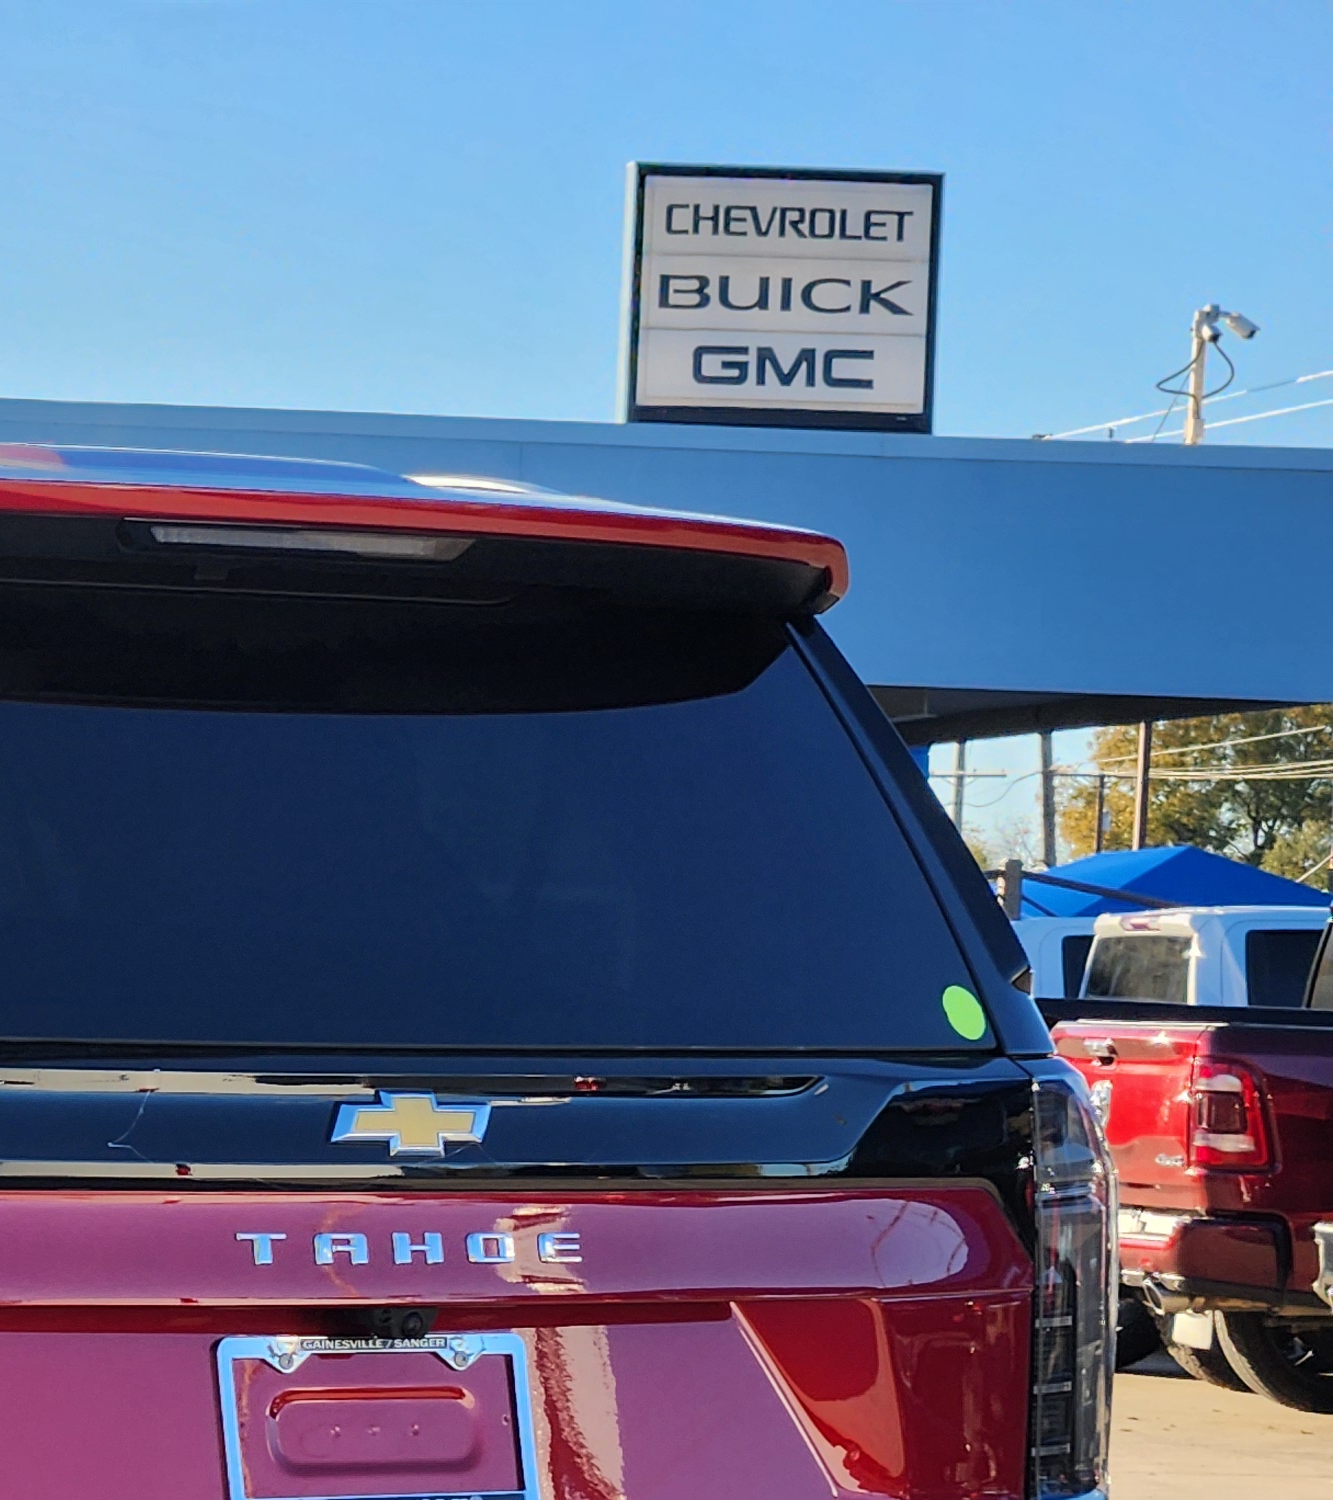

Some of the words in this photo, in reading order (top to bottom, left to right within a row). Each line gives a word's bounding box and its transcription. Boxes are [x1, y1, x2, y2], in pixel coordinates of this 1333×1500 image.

[665, 203, 914, 242] CHEVROLET
[658, 274, 914, 316] BUICK
[692, 345, 874, 389] GMC
[235, 1232, 583, 1265] TAHOE
[394, 1338, 445, 1348] SANGER
